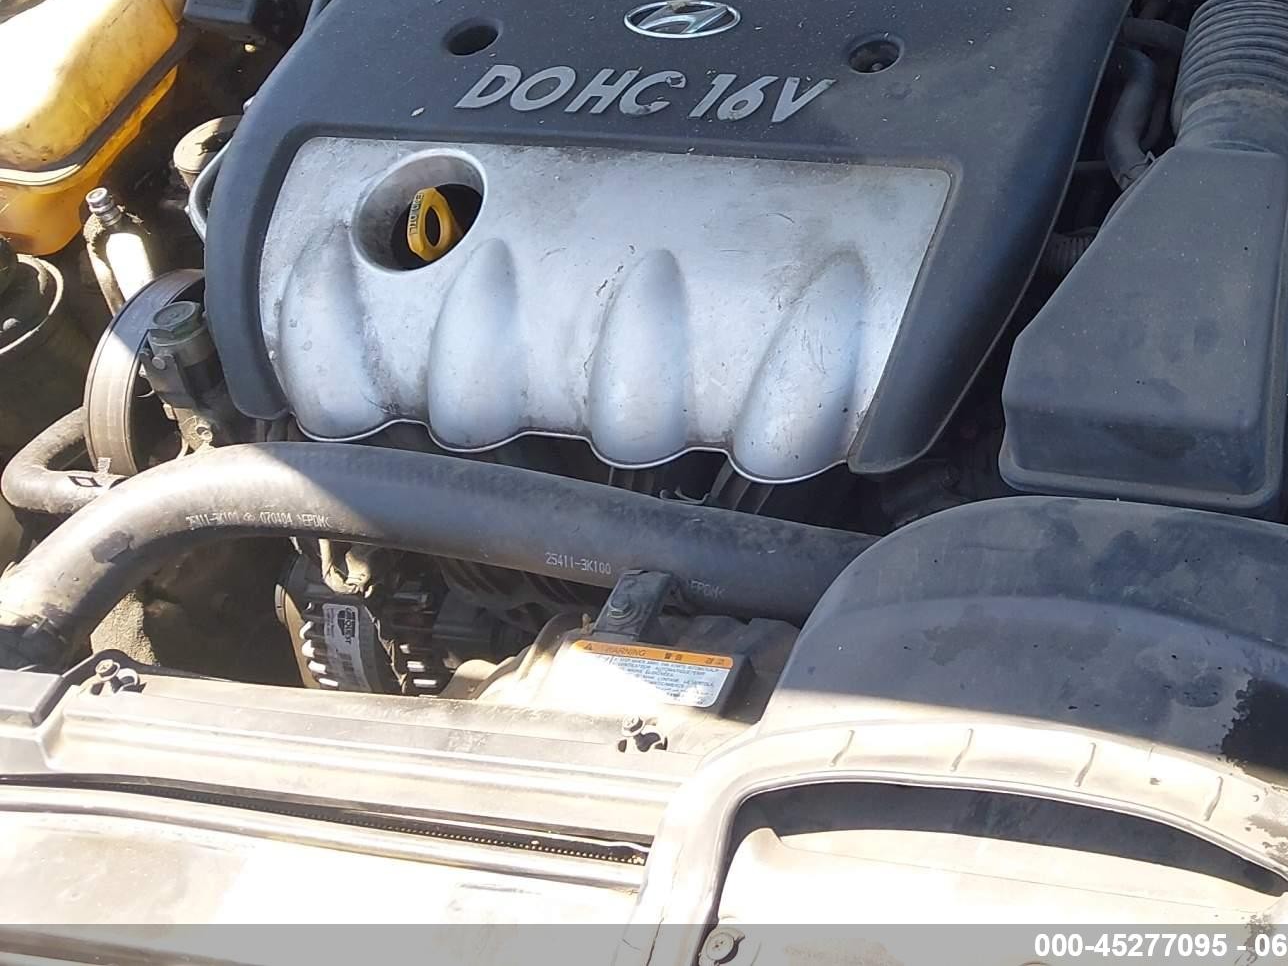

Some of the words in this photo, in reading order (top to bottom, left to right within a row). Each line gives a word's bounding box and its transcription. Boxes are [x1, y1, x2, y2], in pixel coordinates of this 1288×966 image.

[454, 65, 687, 117] DOHC
[688, 74, 836, 122] 16V
[409, 216, 417, 234] OIL
[544, 552, 612, 575] 25411-3K100
[605, 645, 649, 657] WARNING
